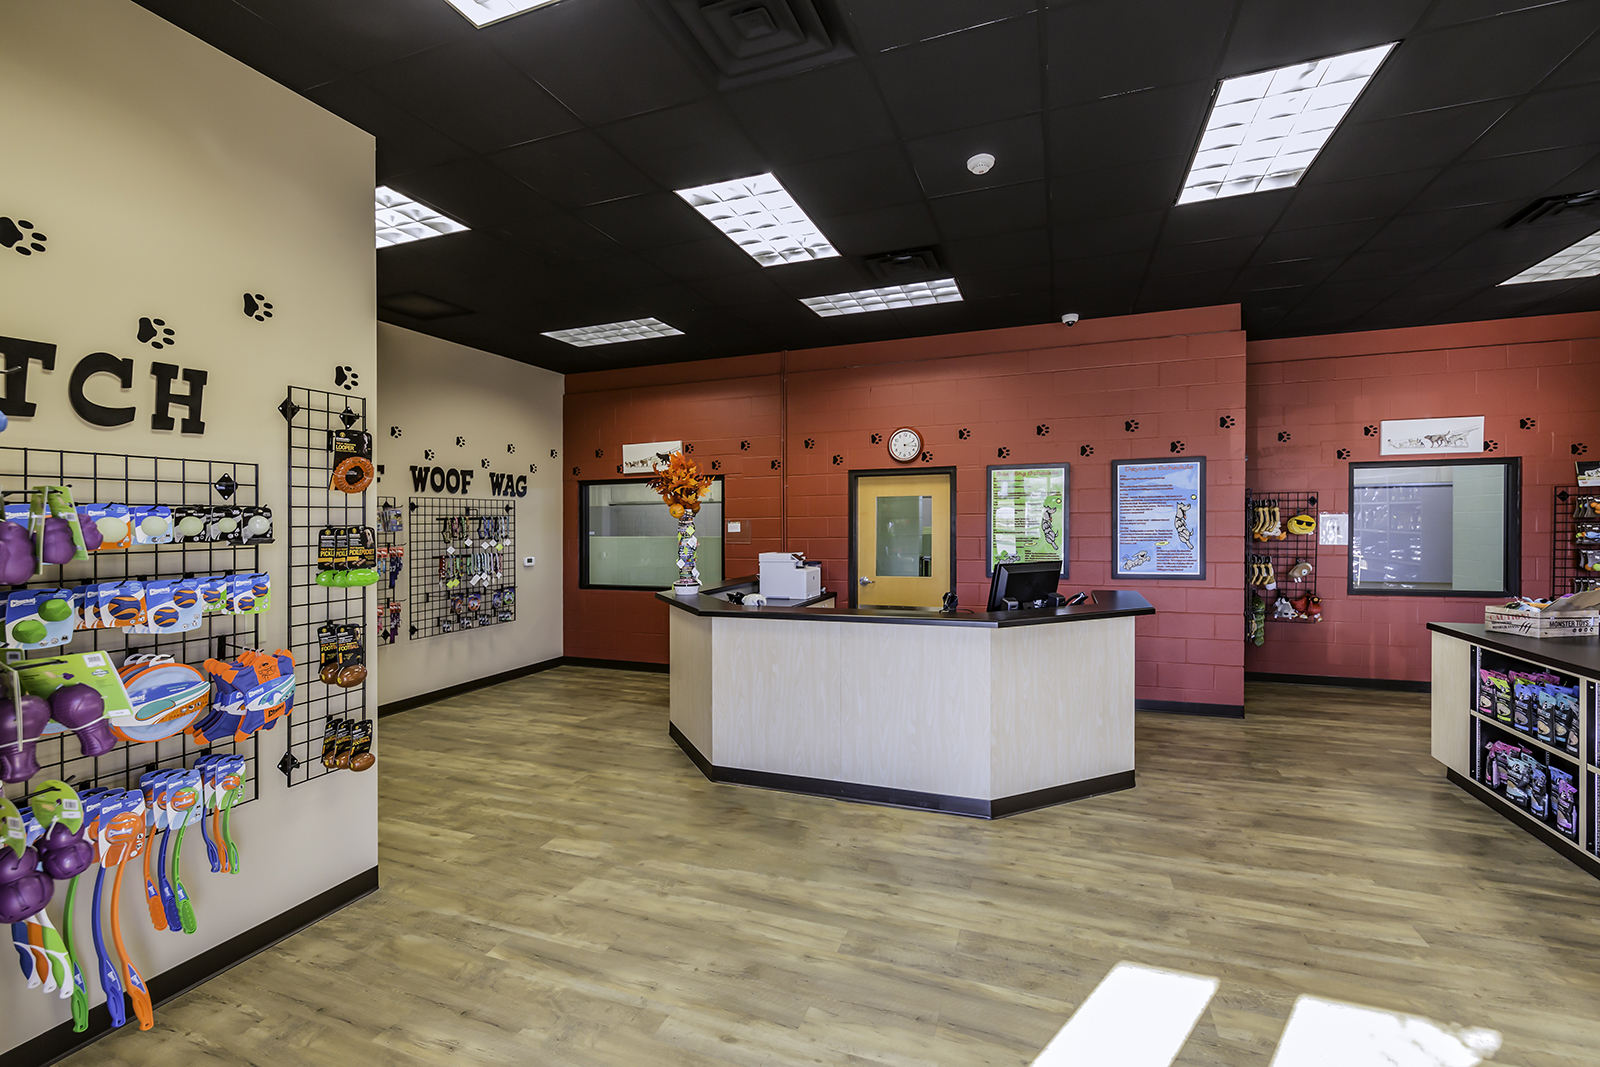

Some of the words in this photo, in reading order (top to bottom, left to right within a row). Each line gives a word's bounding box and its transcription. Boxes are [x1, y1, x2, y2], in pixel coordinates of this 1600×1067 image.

[409, 465, 474, 494] WOOF
[489, 472, 528, 498] WAG
[1489, 613, 1531, 621] CAUTION!
[1549, 620, 1575, 628] MONSTER
